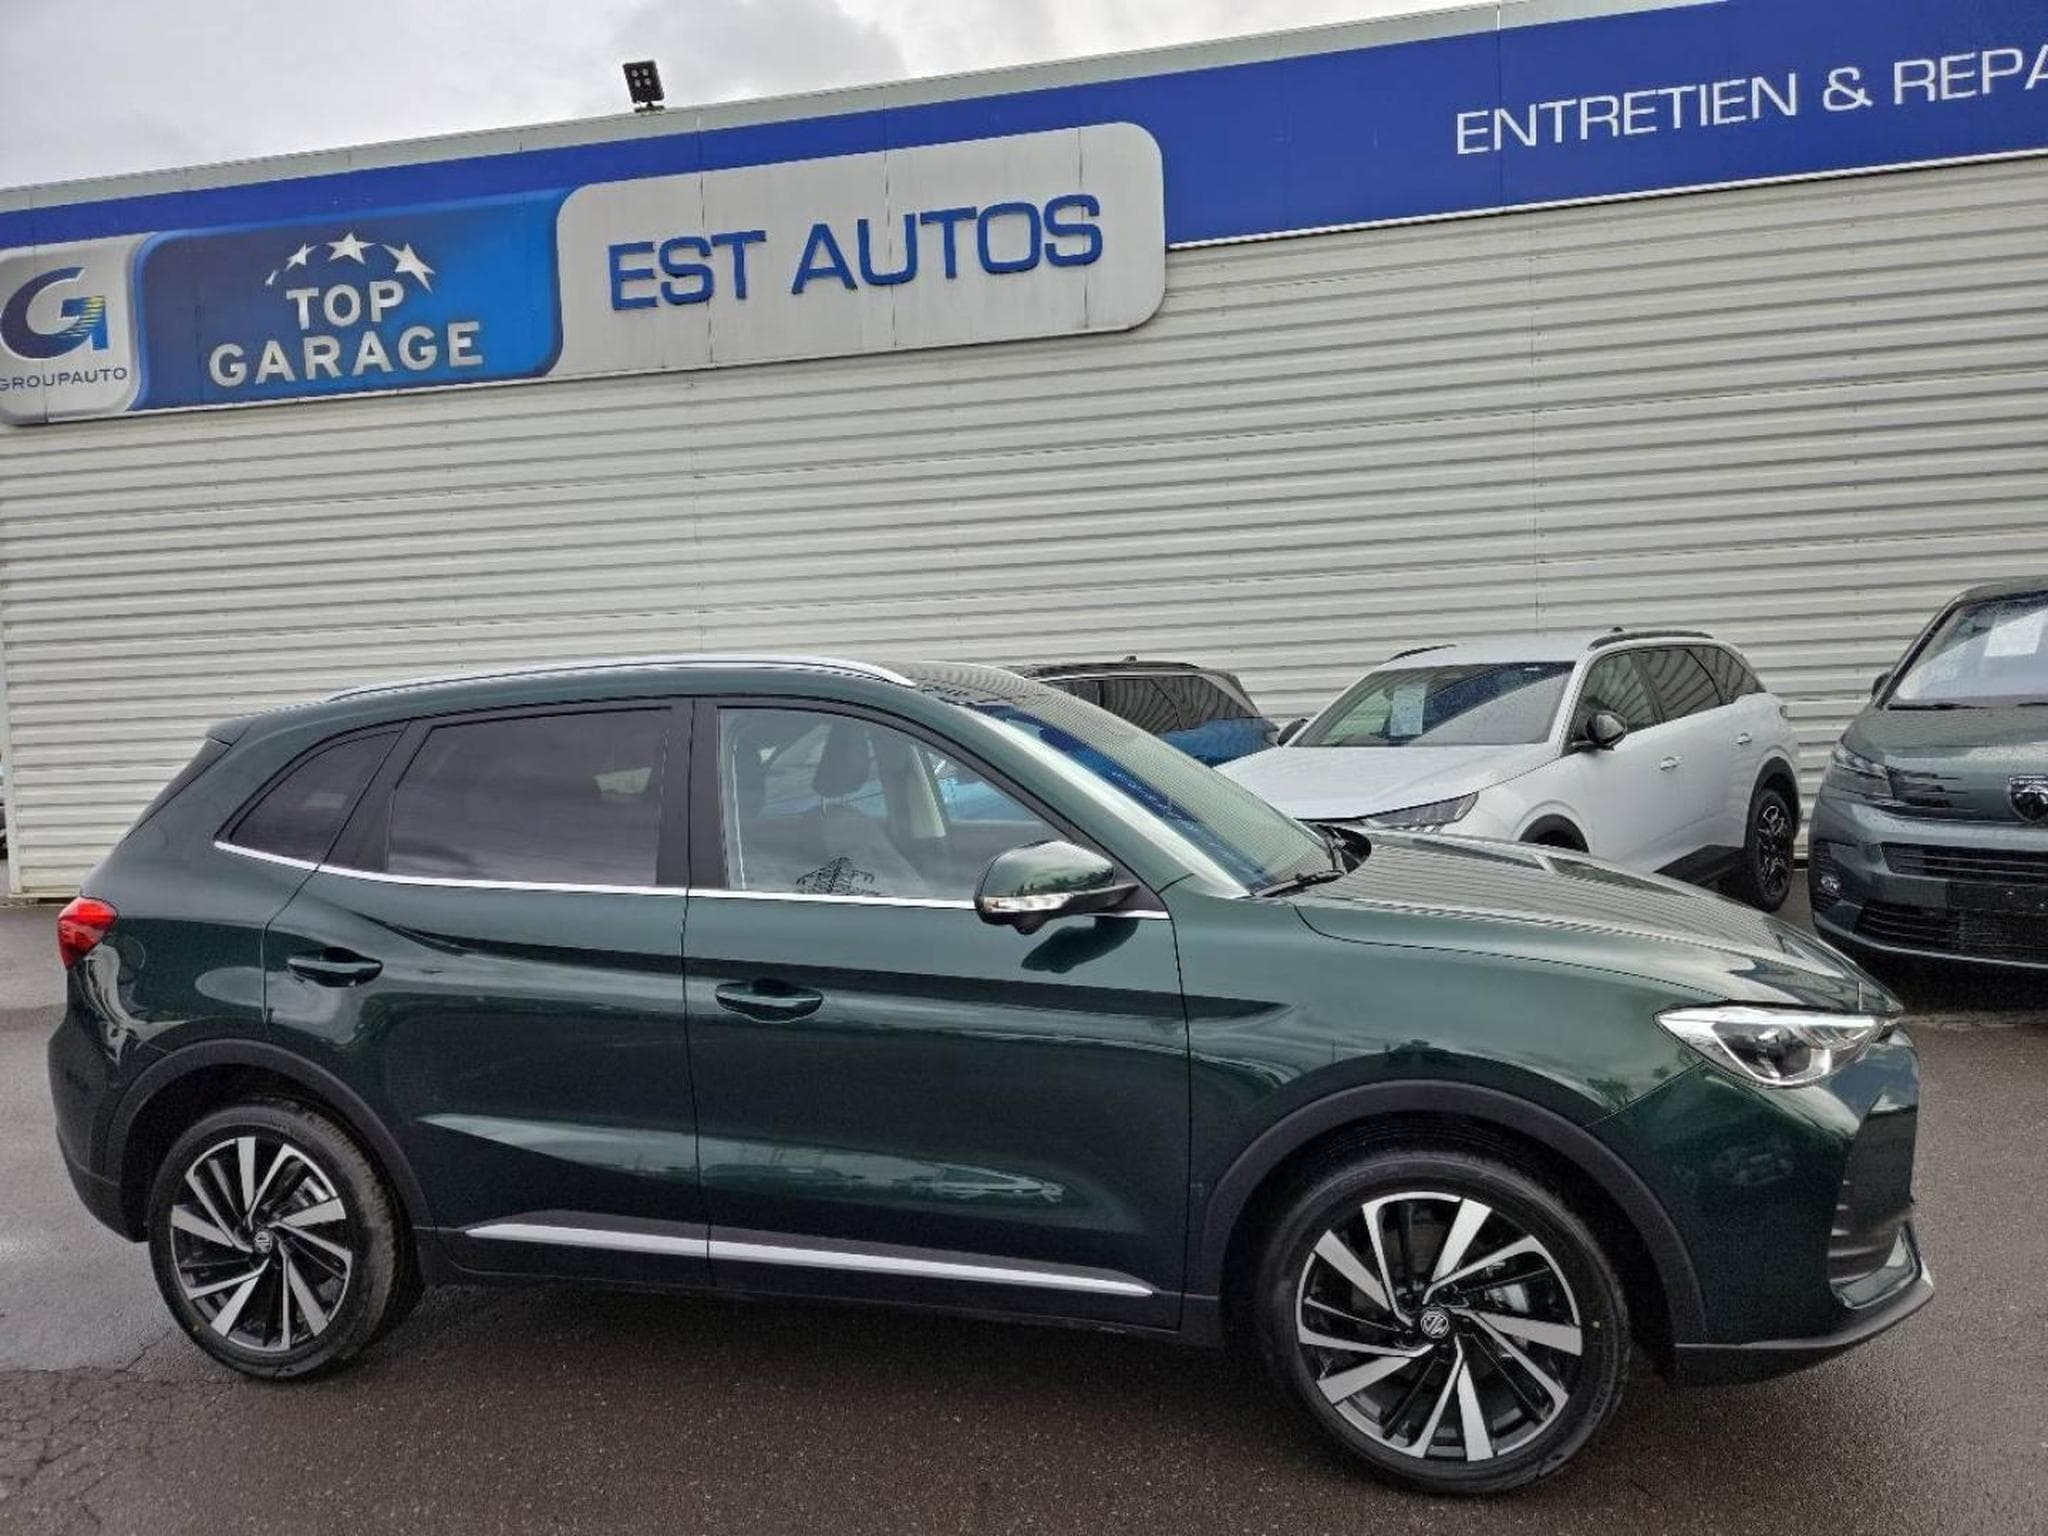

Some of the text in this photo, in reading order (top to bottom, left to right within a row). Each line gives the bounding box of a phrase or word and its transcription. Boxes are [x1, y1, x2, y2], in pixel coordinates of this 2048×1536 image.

[1456, 72, 1797, 155] ENTRETIEN
[1822, 67, 1873, 113] &
[608, 194, 1104, 311] EST AUTOS
[285, 279, 405, 331] TOP
[0, 367, 128, 392] GROUPAUTO
[208, 320, 484, 388] GARAGE
